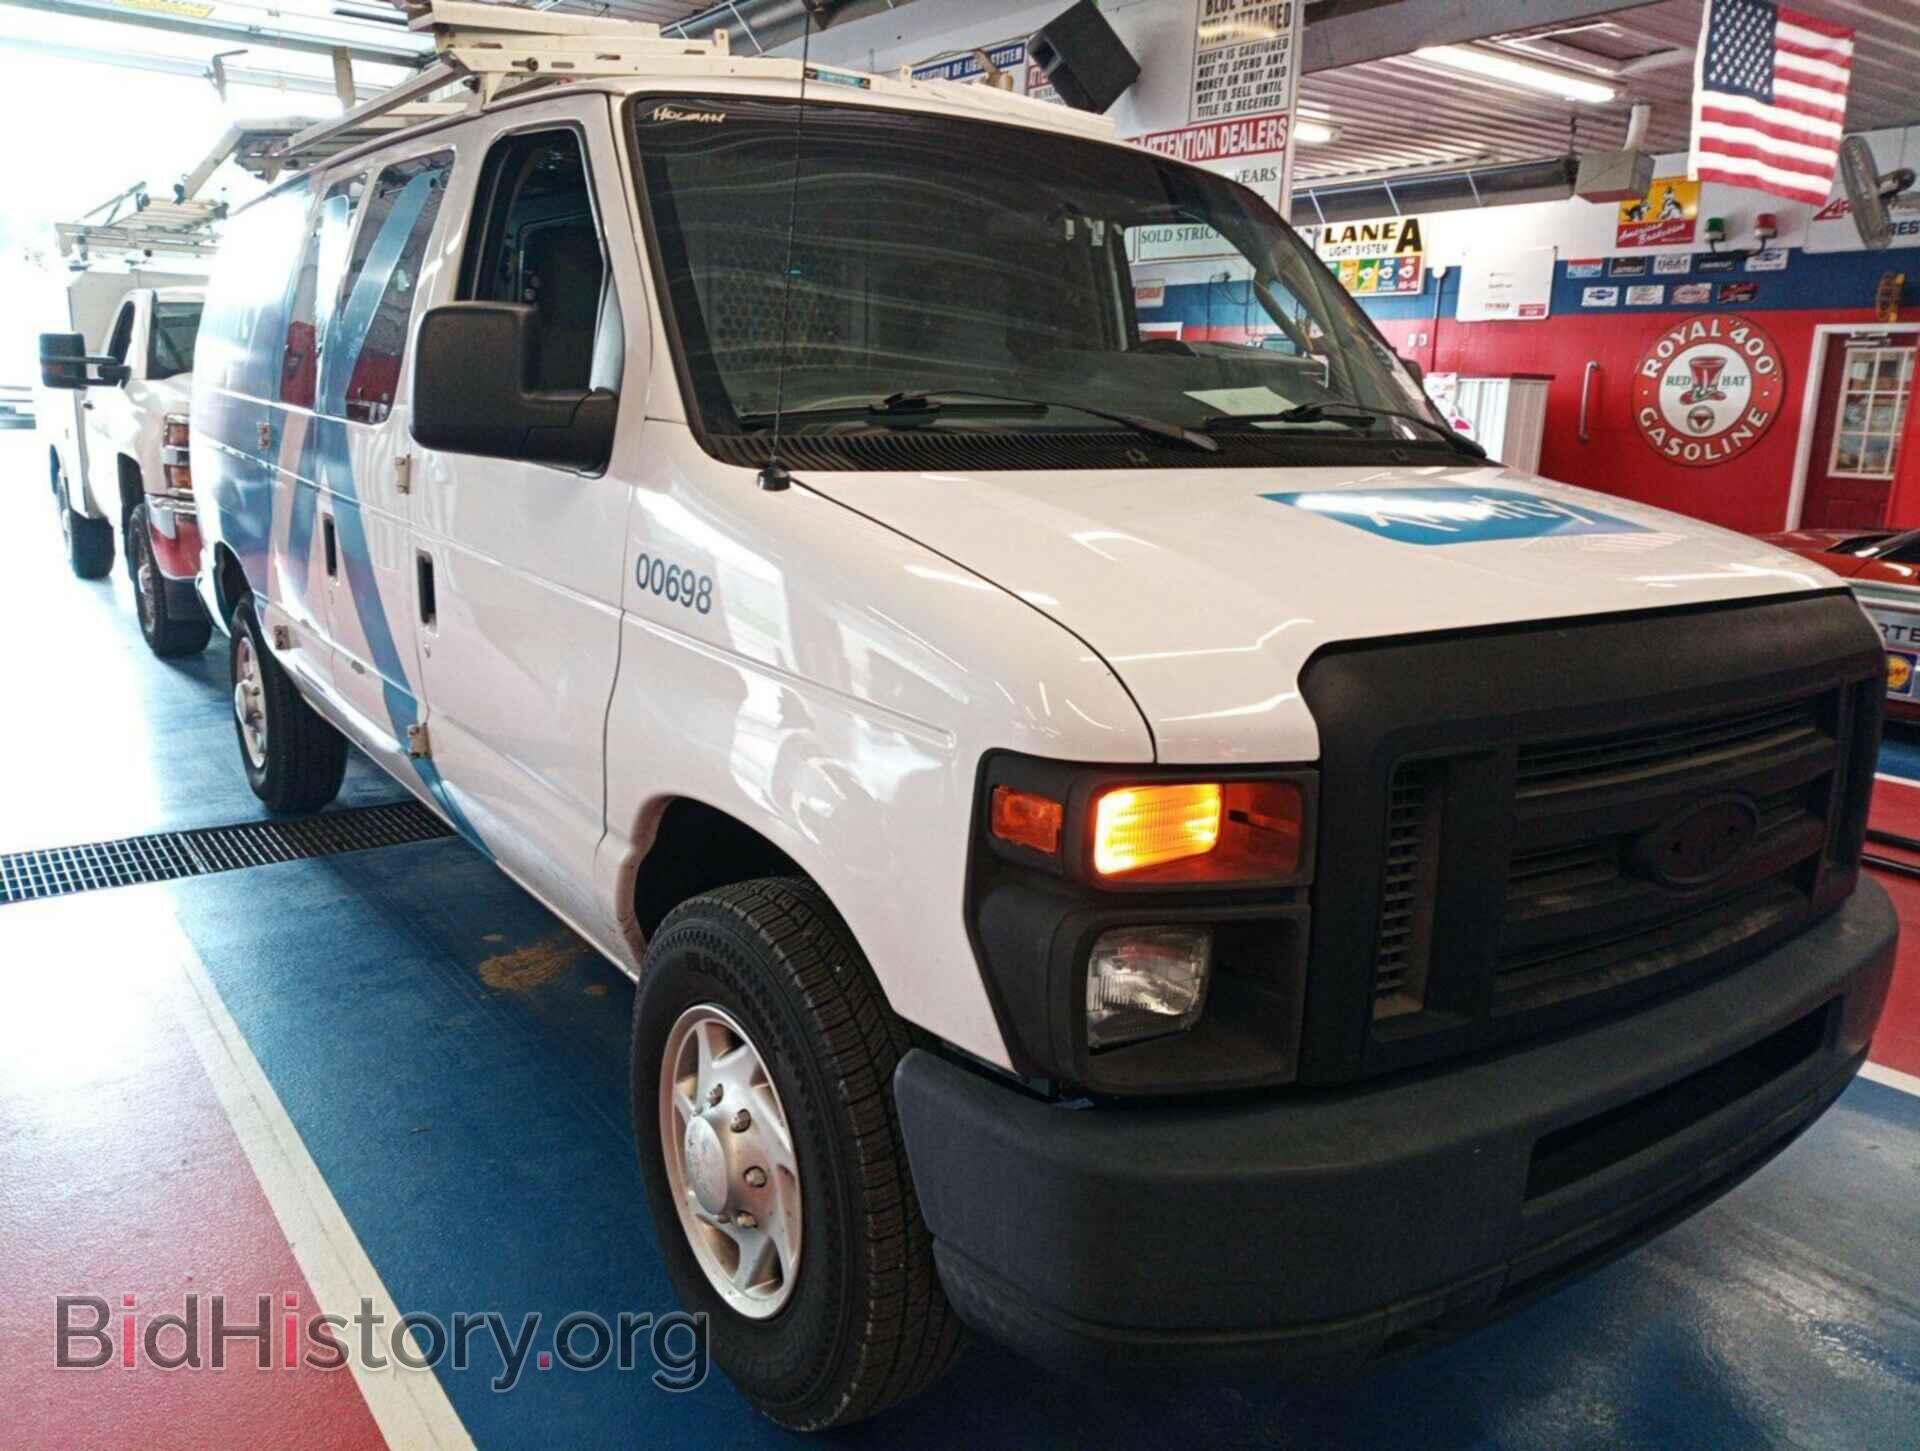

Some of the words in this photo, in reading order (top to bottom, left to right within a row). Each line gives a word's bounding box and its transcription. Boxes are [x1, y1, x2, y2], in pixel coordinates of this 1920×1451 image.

[1231, 2, 1291, 37] ATTACHED
[953, 61, 962, 76] OF
[991, 46, 1023, 66] SYSTEM
[1198, 50, 1223, 65] BUYER
[1226, 47, 1235, 59] IS
[1239, 38, 1288, 57] CAUTIONED
[1199, 65, 1215, 78] NOT
[1218, 62, 1228, 74] TO
[1232, 57, 1261, 72] SPEND
[1265, 52, 1285, 65] ANY
[1196, 77, 1223, 91] MONEY
[1227, 74, 1239, 86] ON
[1243, 70, 1264, 83] UNIT
[1267, 66, 1287, 78] AND
[1198, 91, 1213, 104] NOT
[1217, 89, 1227, 101] TO
[1231, 85, 1251, 99] SELL
[1256, 80, 1282, 95] UNTIL
[1198, 103, 1219, 117] TITLE
[1223, 102, 1232, 113] IS
[1236, 94, 1280, 111] RECEIVED
[1220, 116, 1288, 155] DEALERS
[1234, 166, 1278, 183] YEARS
[1141, 229, 1173, 244] SOLD
[1324, 222, 1398, 244] LANE
[1395, 218, 1423, 253] A
[1888, 221, 1920, 236] RES
[1329, 246, 1352, 256] LIGHT
[1356, 243, 1389, 256] SYSTEM
[1641, 318, 1722, 379] ROYAL
[1665, 375, 1691, 387] RED
[1721, 375, 1747, 387] HAT
[1639, 406, 1769, 461] GASOLINE
[636, 552, 713, 615] 00698
